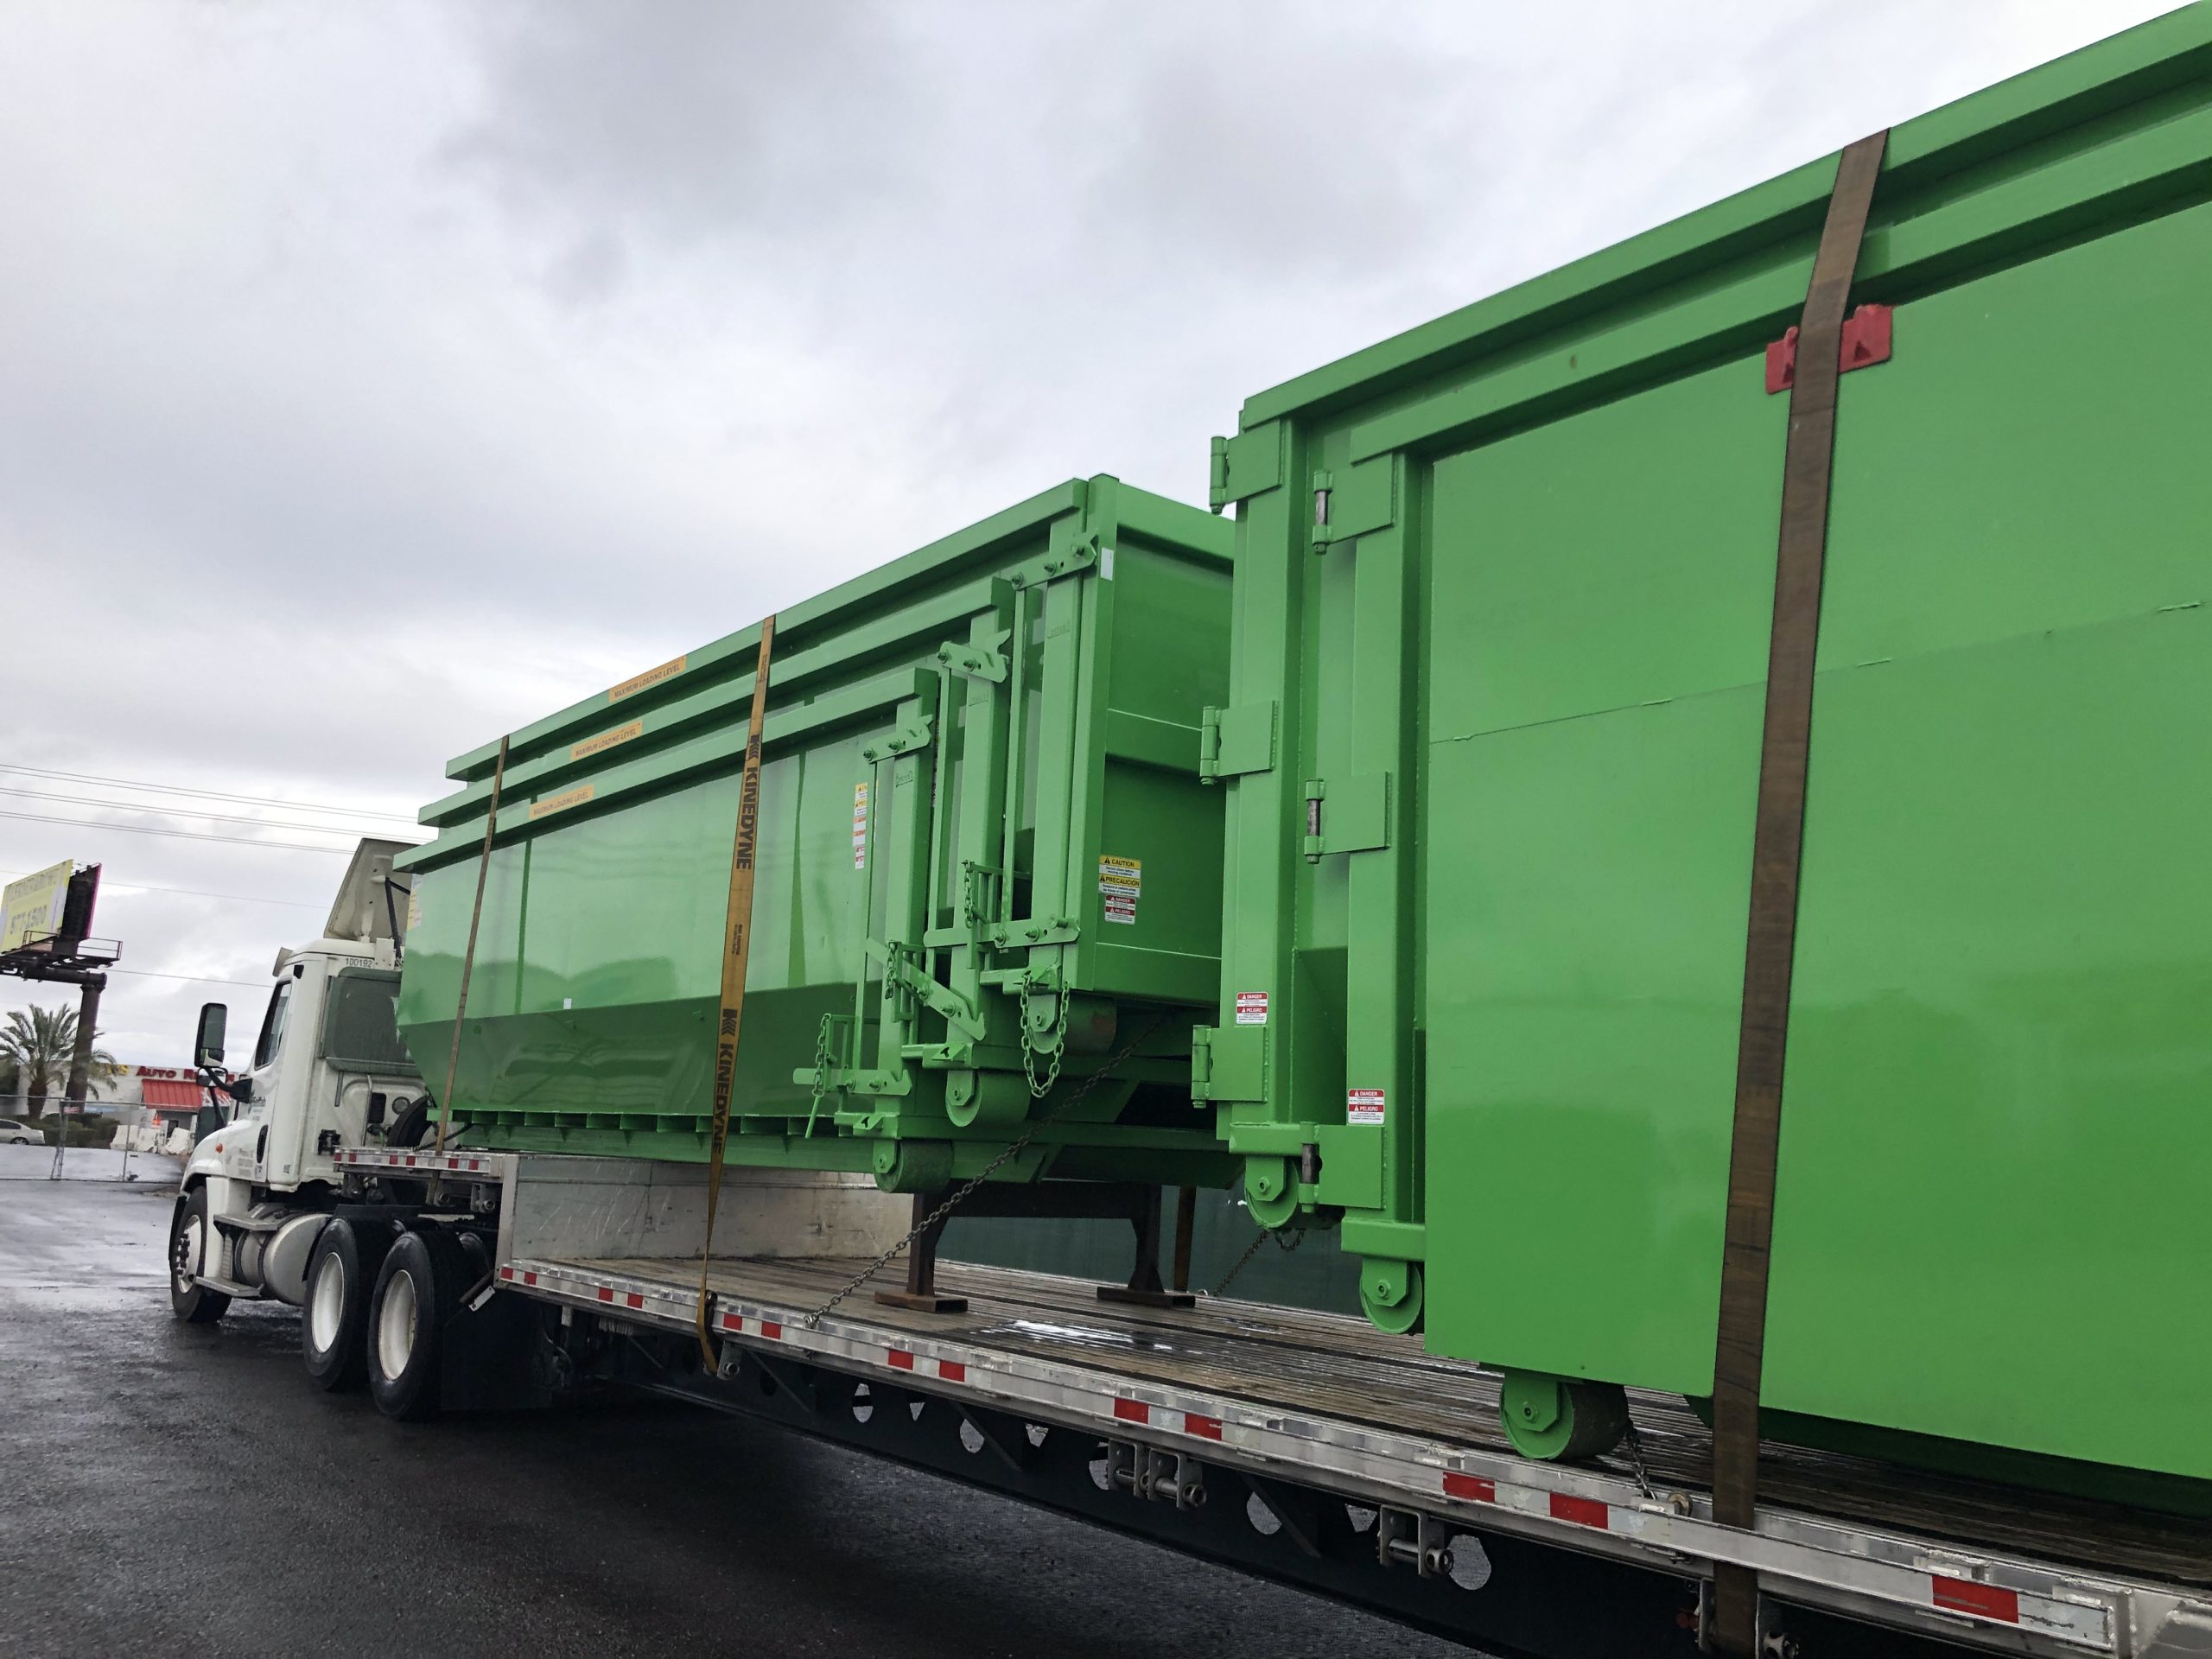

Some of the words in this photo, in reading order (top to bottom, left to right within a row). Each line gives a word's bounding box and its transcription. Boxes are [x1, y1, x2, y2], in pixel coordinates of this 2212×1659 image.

[614, 681, 639, 697] MAXIMUM
[639, 671, 663, 688] LOADING
[663, 664, 680, 677] LEVEL
[575, 743, 598, 757] MAXIMUM
[598, 734, 620, 748] LOADING
[620, 728, 637, 741] LEVEL
[735, 766, 759, 870] KINEDYNE
[1111, 858, 1135, 868] CAUTION
[346, 957, 373, 968] 100192
[137, 1065, 177, 1079] AUTO
[713, 1043, 734, 1154] KINEDYNE
